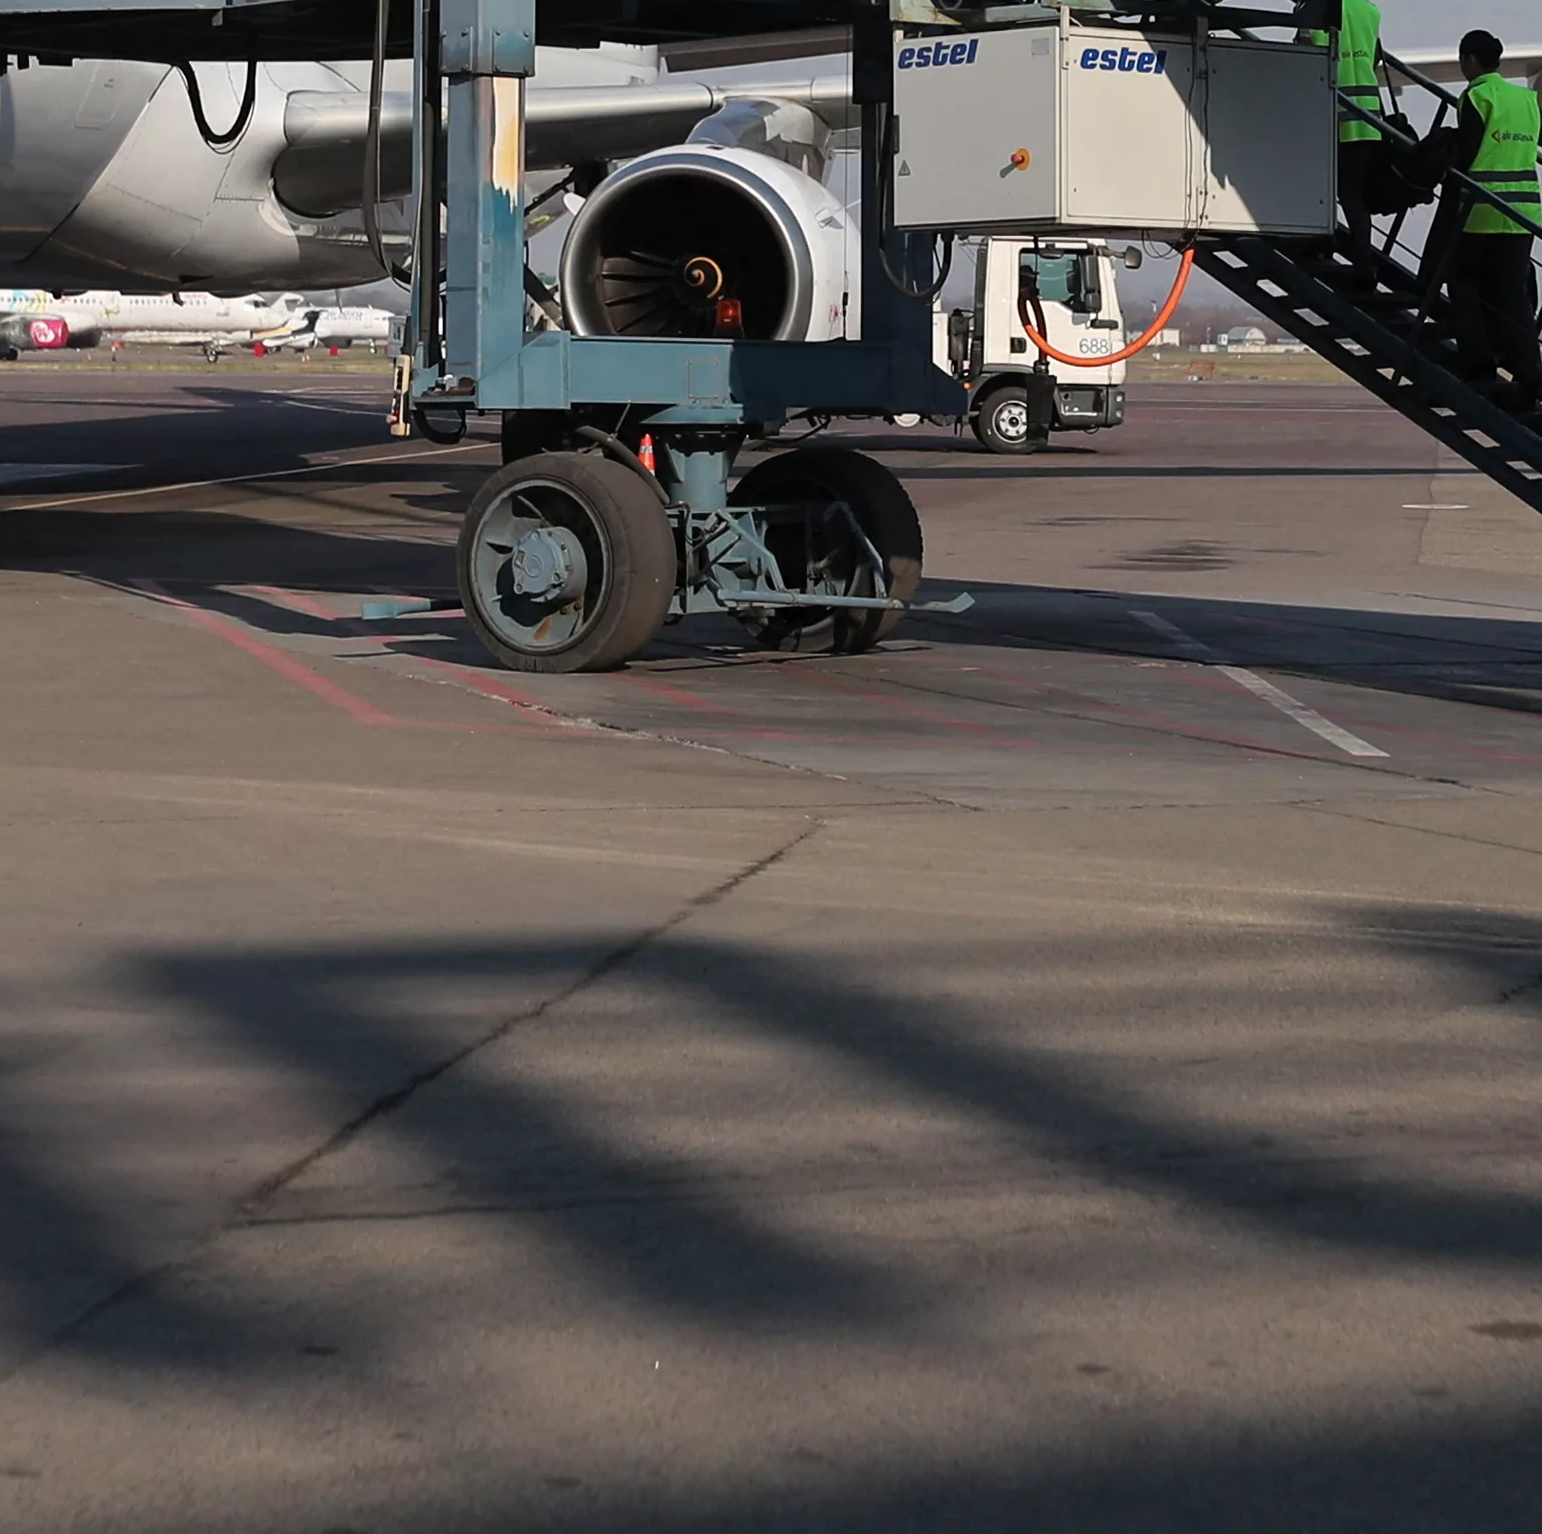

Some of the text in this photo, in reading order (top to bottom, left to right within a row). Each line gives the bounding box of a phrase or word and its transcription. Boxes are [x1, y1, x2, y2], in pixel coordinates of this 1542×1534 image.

[897, 38, 979, 70] estel
[1079, 46, 1168, 75] estel
[1079, 338, 1109, 355] 688
